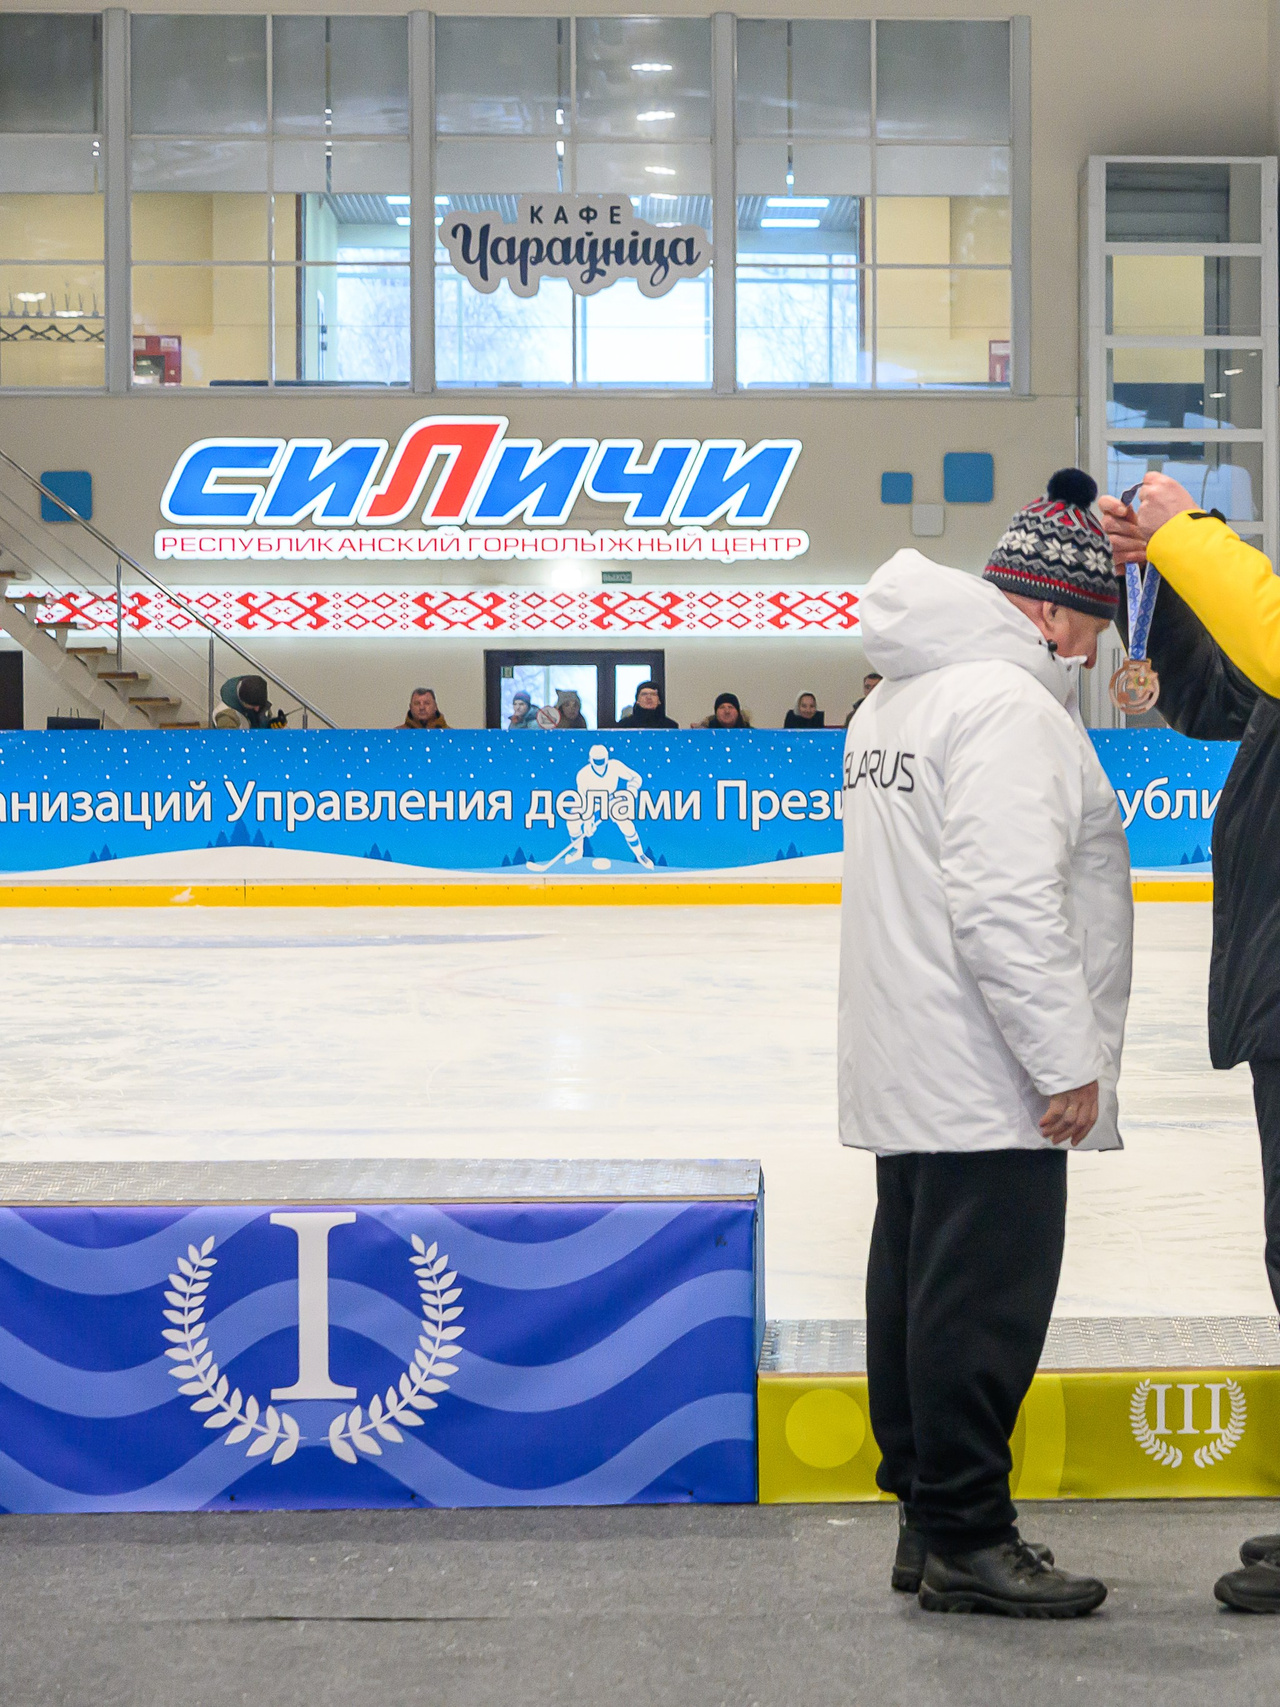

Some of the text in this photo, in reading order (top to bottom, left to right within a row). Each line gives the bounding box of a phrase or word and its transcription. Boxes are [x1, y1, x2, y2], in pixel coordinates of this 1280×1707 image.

[530, 204, 622, 225] КАФЕ
[451, 222, 701, 287] Чараўніца
[161, 532, 802, 555] РЕСПУБЛИКАНСКИЙ ГОРНОЛЫЖНЫЙ ЦЕНТР
[223, 780, 512, 833] Управления
[525, 789, 701, 829] делами
[269, 1211, 358, 1400] I
[1149, 1383, 1228, 1435] III
